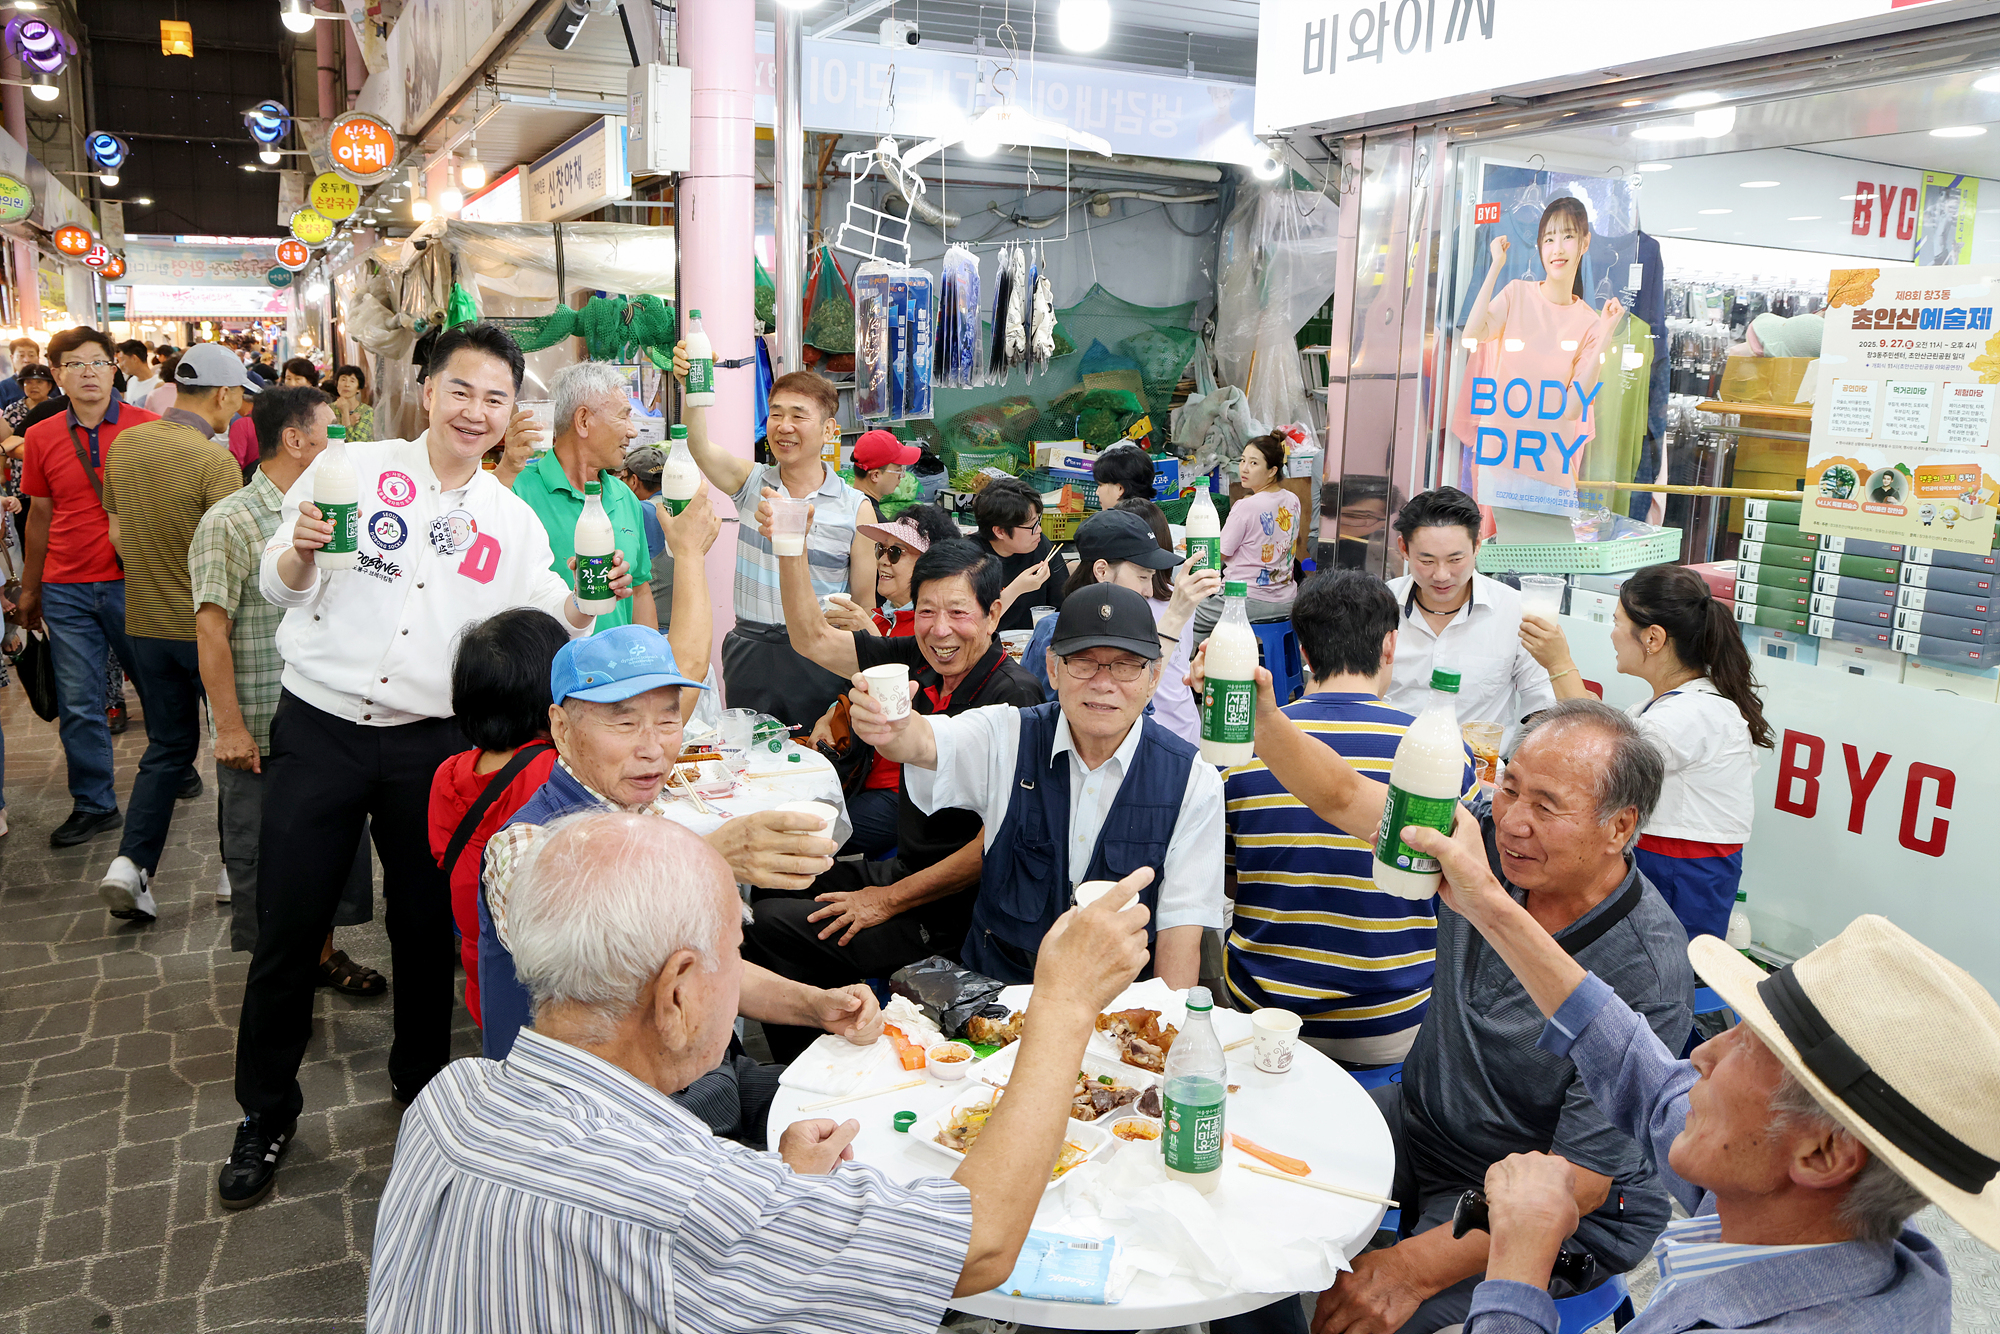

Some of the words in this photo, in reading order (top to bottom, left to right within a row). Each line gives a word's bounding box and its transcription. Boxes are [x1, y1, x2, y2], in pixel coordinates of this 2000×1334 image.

[344, 124, 376, 140] 신창
[338, 143, 386, 166] 야채
[548, 154, 583, 209] 신창야채
[319, 182, 350, 194] 홍두깨
[314, 196, 356, 210] 손칼국수
[1478, 205, 1497, 221] BYC
[1852, 181, 1918, 240] BYC
[296, 224, 330, 234] 손칼국수
[1895, 290, 1922, 301] 제8회
[1924, 289, 1951, 300] 창3동
[1851, 307, 1993, 330] 초안산예술제
[1880, 339, 1888, 348] 9.
[1915, 341, 1928, 349] 오전
[1929, 341, 1942, 349] 11시
[1950, 341, 1963, 349] 오후
[1908, 352, 1951, 360] 초안산근린공원
[1842, 384, 1868, 393] 공연마당
[1893, 386, 1927, 395] 먹거리마당
[1954, 388, 1984, 398] 체험마당
[1470, 377, 1604, 422] BODY
[1474, 426, 1589, 476] DRY
[1558, 489, 1570, 497] BYC
[382, 512, 399, 521] SEOUL
[432, 522, 447, 553] 오언석
[457, 532, 502, 585] D
[1229, 694, 1247, 705] 서울
[1228, 704, 1247, 712] 미래
[1228, 712, 1248, 723] 유산
[1774, 728, 1956, 858] BYC
[1198, 1118, 1220, 1130] 서울
[1198, 1130, 1219, 1140] 미래
[1198, 1138, 1219, 1150] 유산
